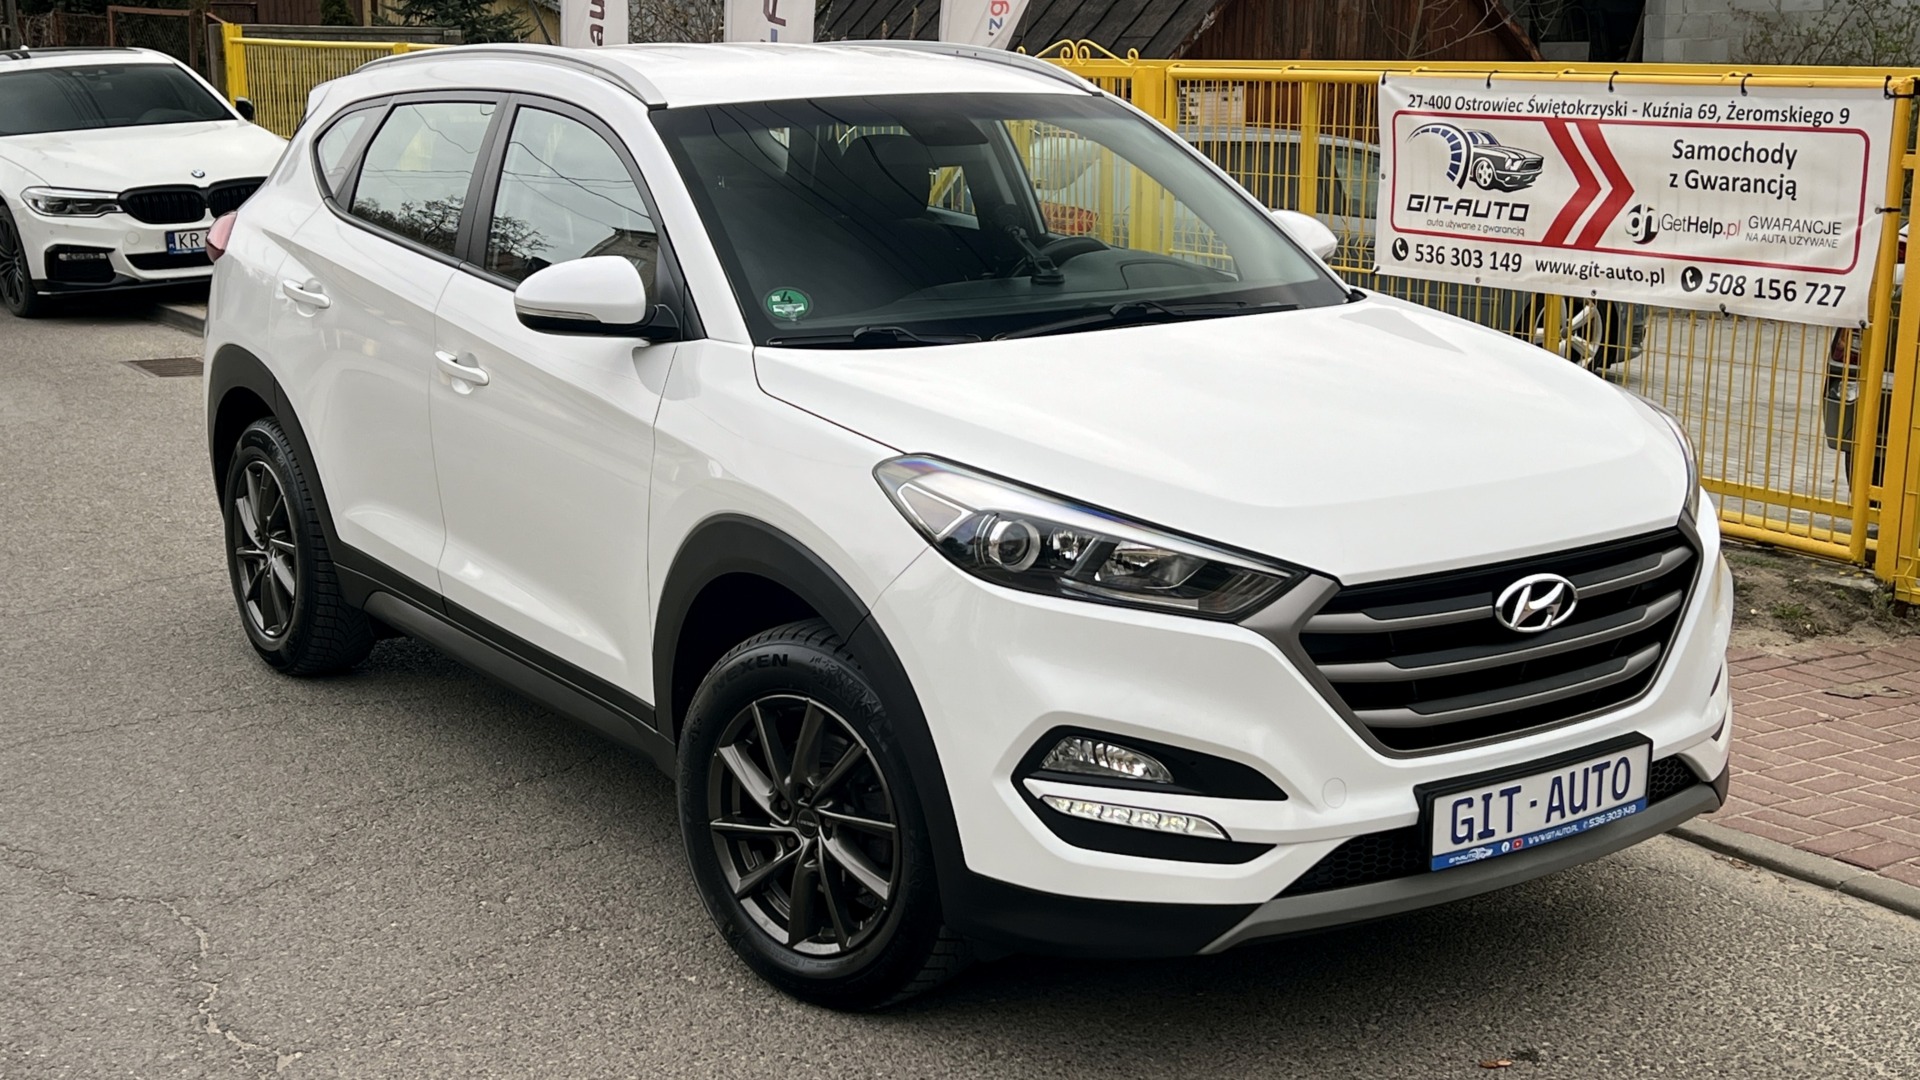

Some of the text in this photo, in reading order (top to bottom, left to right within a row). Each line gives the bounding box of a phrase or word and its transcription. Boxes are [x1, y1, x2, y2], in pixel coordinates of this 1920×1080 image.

[1407, 94, 1451, 110] 27-400
[1455, 96, 1524, 113] Ostrowiec
[1526, 94, 1627, 120] Świętokrzyski
[1642, 101, 1693, 119] Kuźnia
[1698, 103, 1721, 122] 69,
[1726, 101, 1834, 127] Żeromskiego
[1839, 107, 1850, 124] 9
[1672, 139, 1797, 169] Samochody
[1669, 169, 1797, 201] z Gwarancją
[1406, 194, 1530, 222] GIT-AUTO
[1426, 218, 1444, 227] auta
[1445, 220, 1476, 231] używane
[1482, 224, 1525, 237] gwarancją
[1661, 213, 1741, 239] GetHelp.pl
[1745, 232, 1759, 242] NA
[1760, 233, 1787, 244] AUTA
[1748, 215, 1842, 235] GWARANCJE
[178, 232, 200, 249] KR
[1414, 243, 1522, 272] 536 303 149
[1535, 259, 1665, 287] www.git-auto.pl
[1705, 273, 1846, 308] 508 156 727
